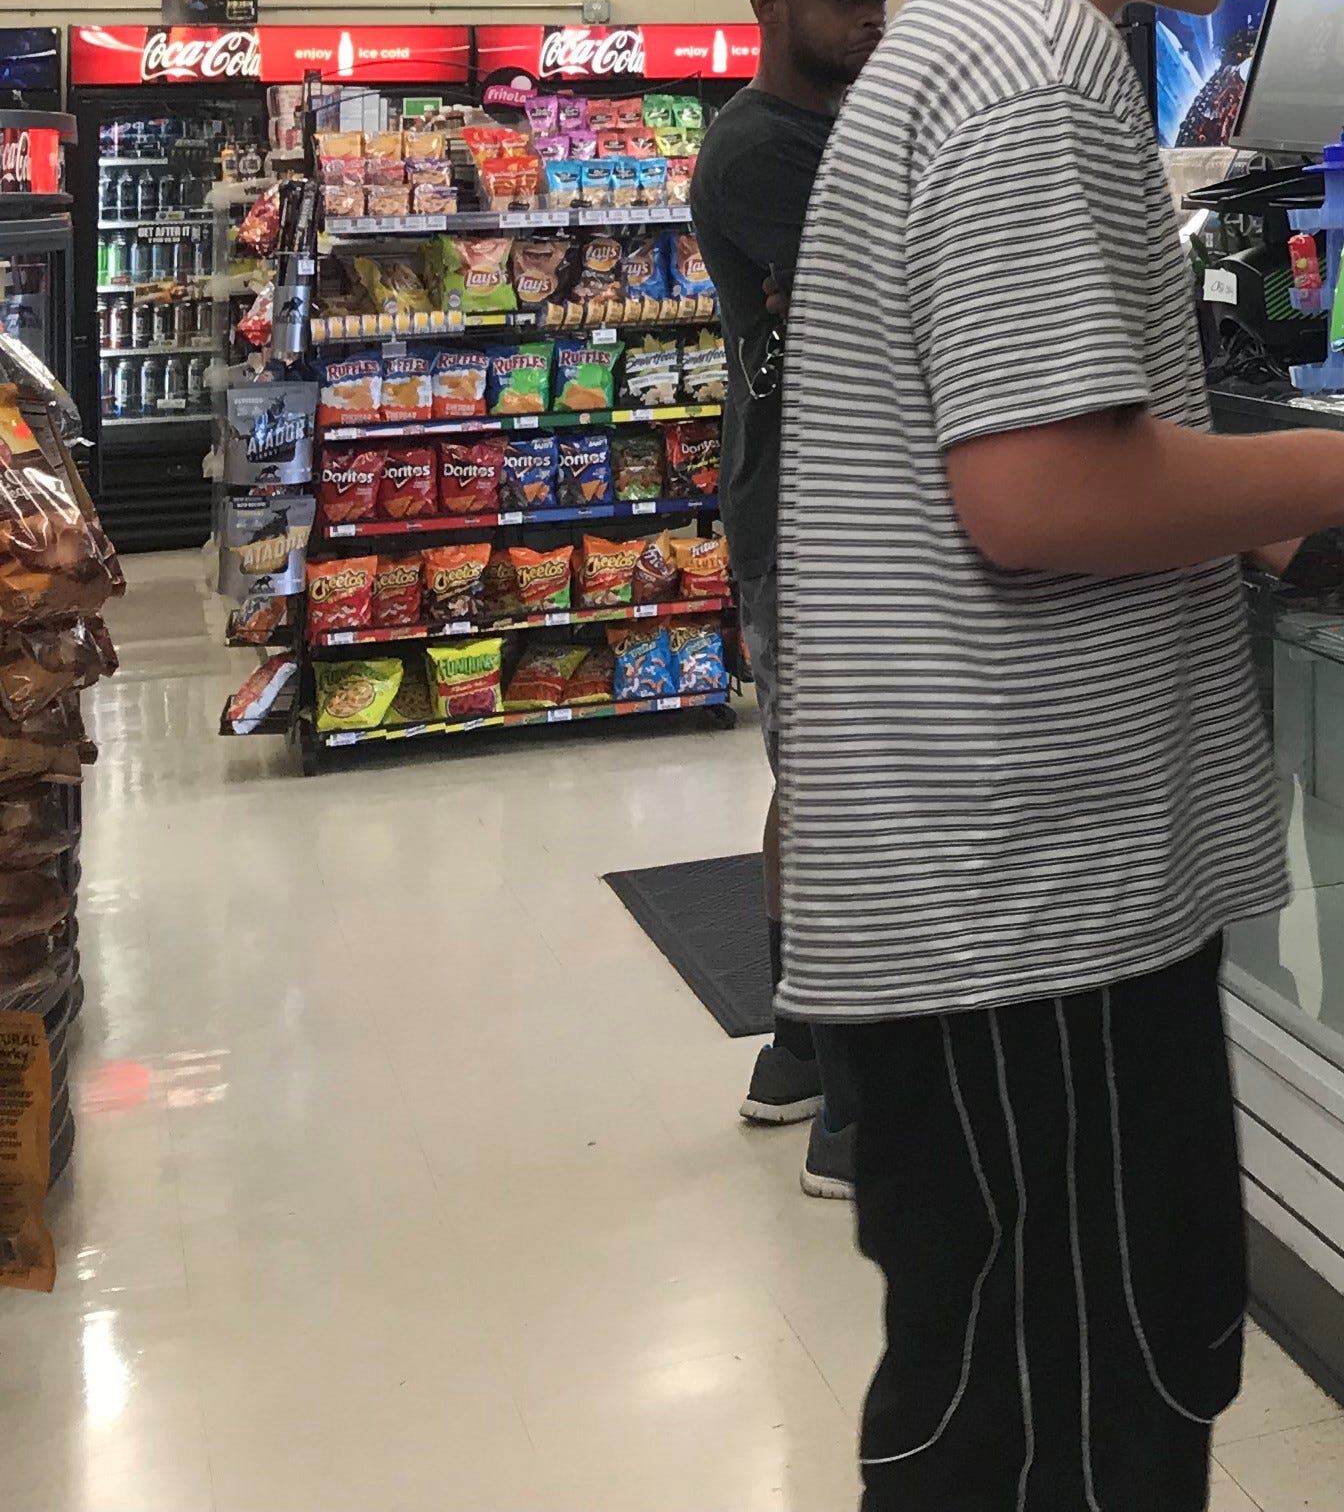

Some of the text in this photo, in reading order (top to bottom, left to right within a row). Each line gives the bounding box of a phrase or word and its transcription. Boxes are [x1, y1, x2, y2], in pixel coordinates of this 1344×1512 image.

[141, 32, 261, 81] Coca-Cola
[294, 47, 409, 60] enjoy ice cold
[539, 30, 645, 78] Coca-Cola
[674, 45, 749, 58] enjoy ice
[326, 360, 379, 381] RUFFLES
[493, 354, 548, 373] RUFFLES
[322, 467, 374, 486] Doritos
[443, 462, 495, 479] Doritos
[311, 568, 365, 600] Cheetos
